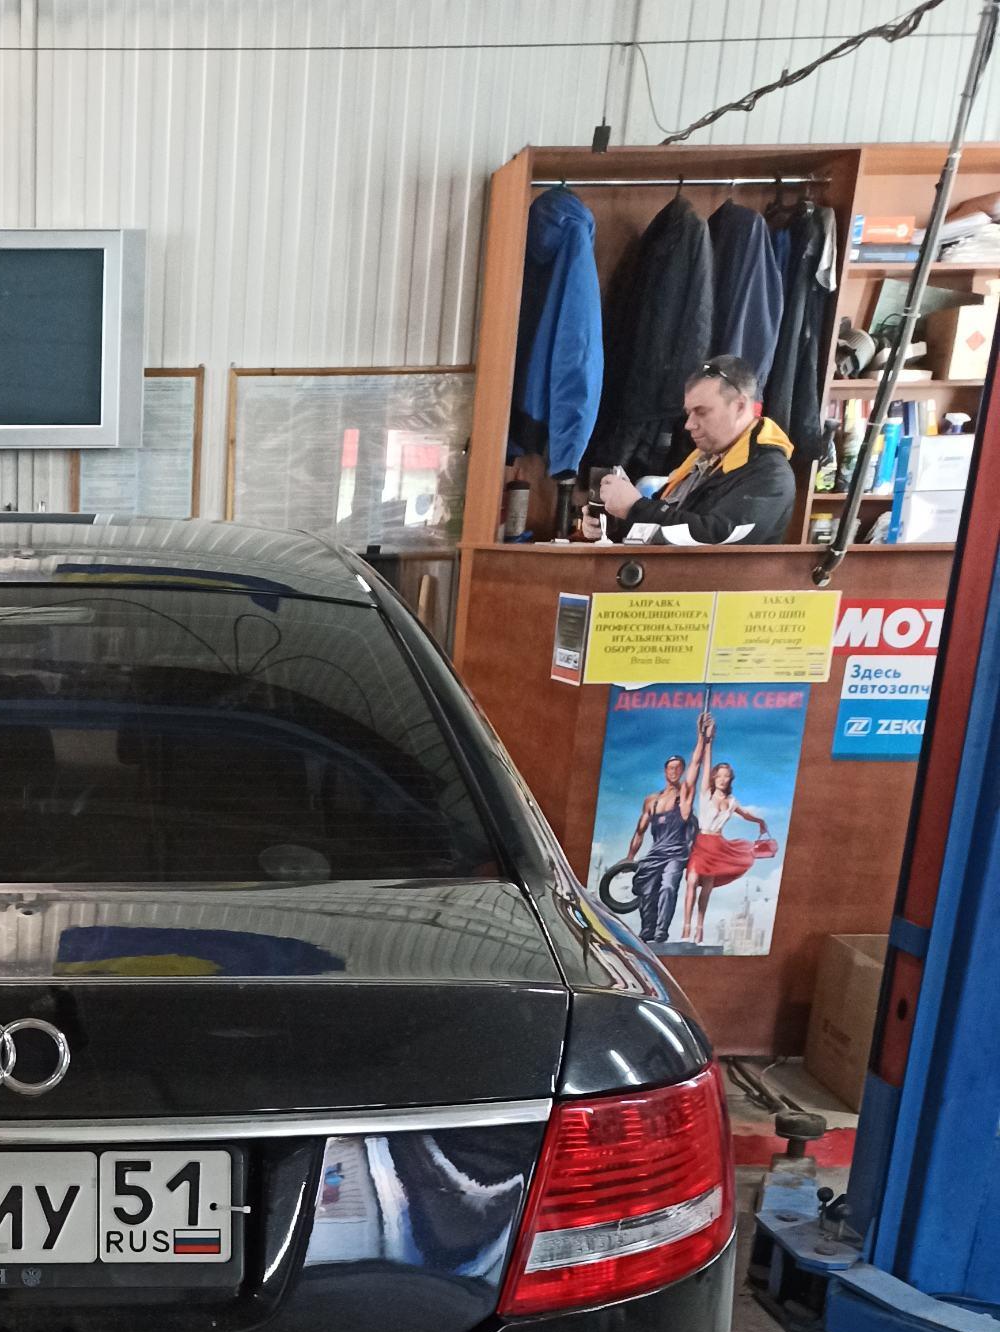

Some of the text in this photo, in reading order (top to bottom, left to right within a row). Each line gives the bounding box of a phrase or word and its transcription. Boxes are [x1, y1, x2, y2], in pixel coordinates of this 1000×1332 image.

[629, 599, 680, 608] ЗАПРАВКА
[763, 596, 795, 604] ЗАКАЗ
[597, 610, 708, 619] АВТОКОНДИЦИОНЕРА
[747, 610, 806, 619] АВТО ШИН
[595, 624, 710, 632] ПРОФЕССИОНАЛЬНЫМ
[611, 635, 689, 643] ИТАЛЬЯНСКИМ
[604, 645, 694, 654] ОБОРУДОВАНИЕМ
[850, 664, 902, 680] Здесь
[613, 692, 703, 711] ДЕЛАЕМ
[711, 692, 748, 709] КАК
[113, 1160, 201, 1226] 51
[106, 1229, 171, 1254] RUS
